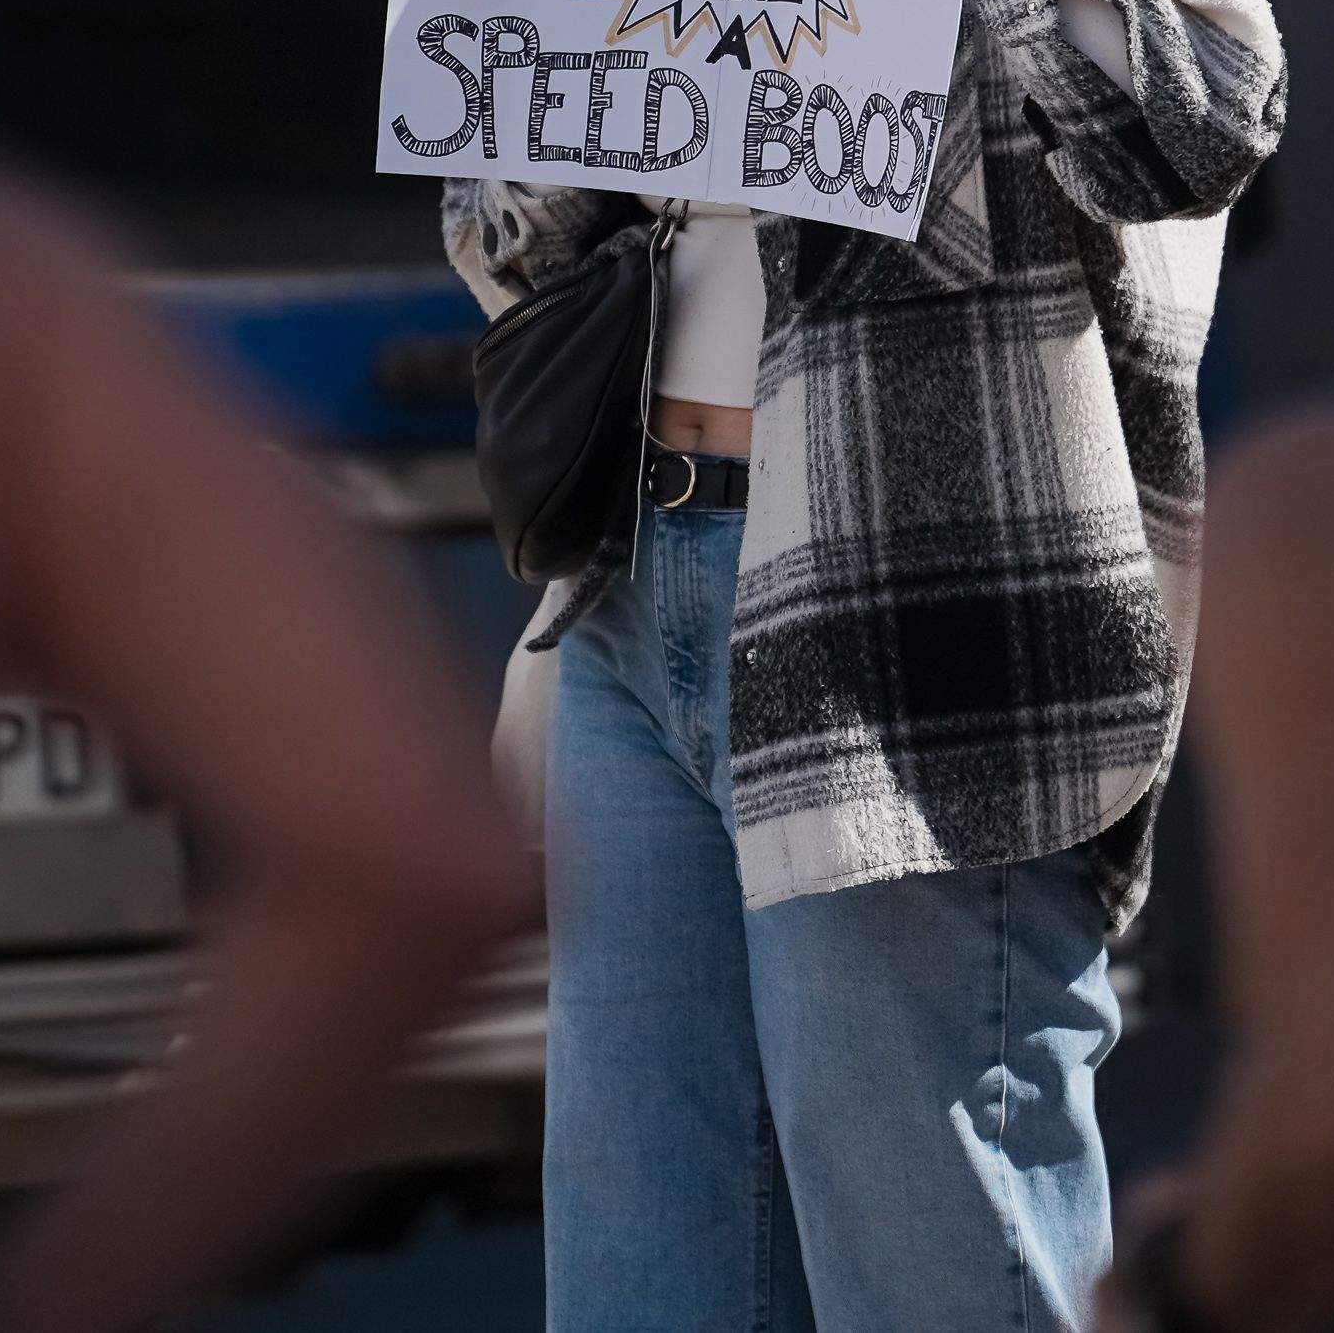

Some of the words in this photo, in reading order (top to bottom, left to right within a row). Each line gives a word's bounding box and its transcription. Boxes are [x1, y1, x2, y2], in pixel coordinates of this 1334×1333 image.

[705, 14, 752, 70] A
[391, 14, 710, 173] SPEED
[741, 68, 947, 214] BOOST
